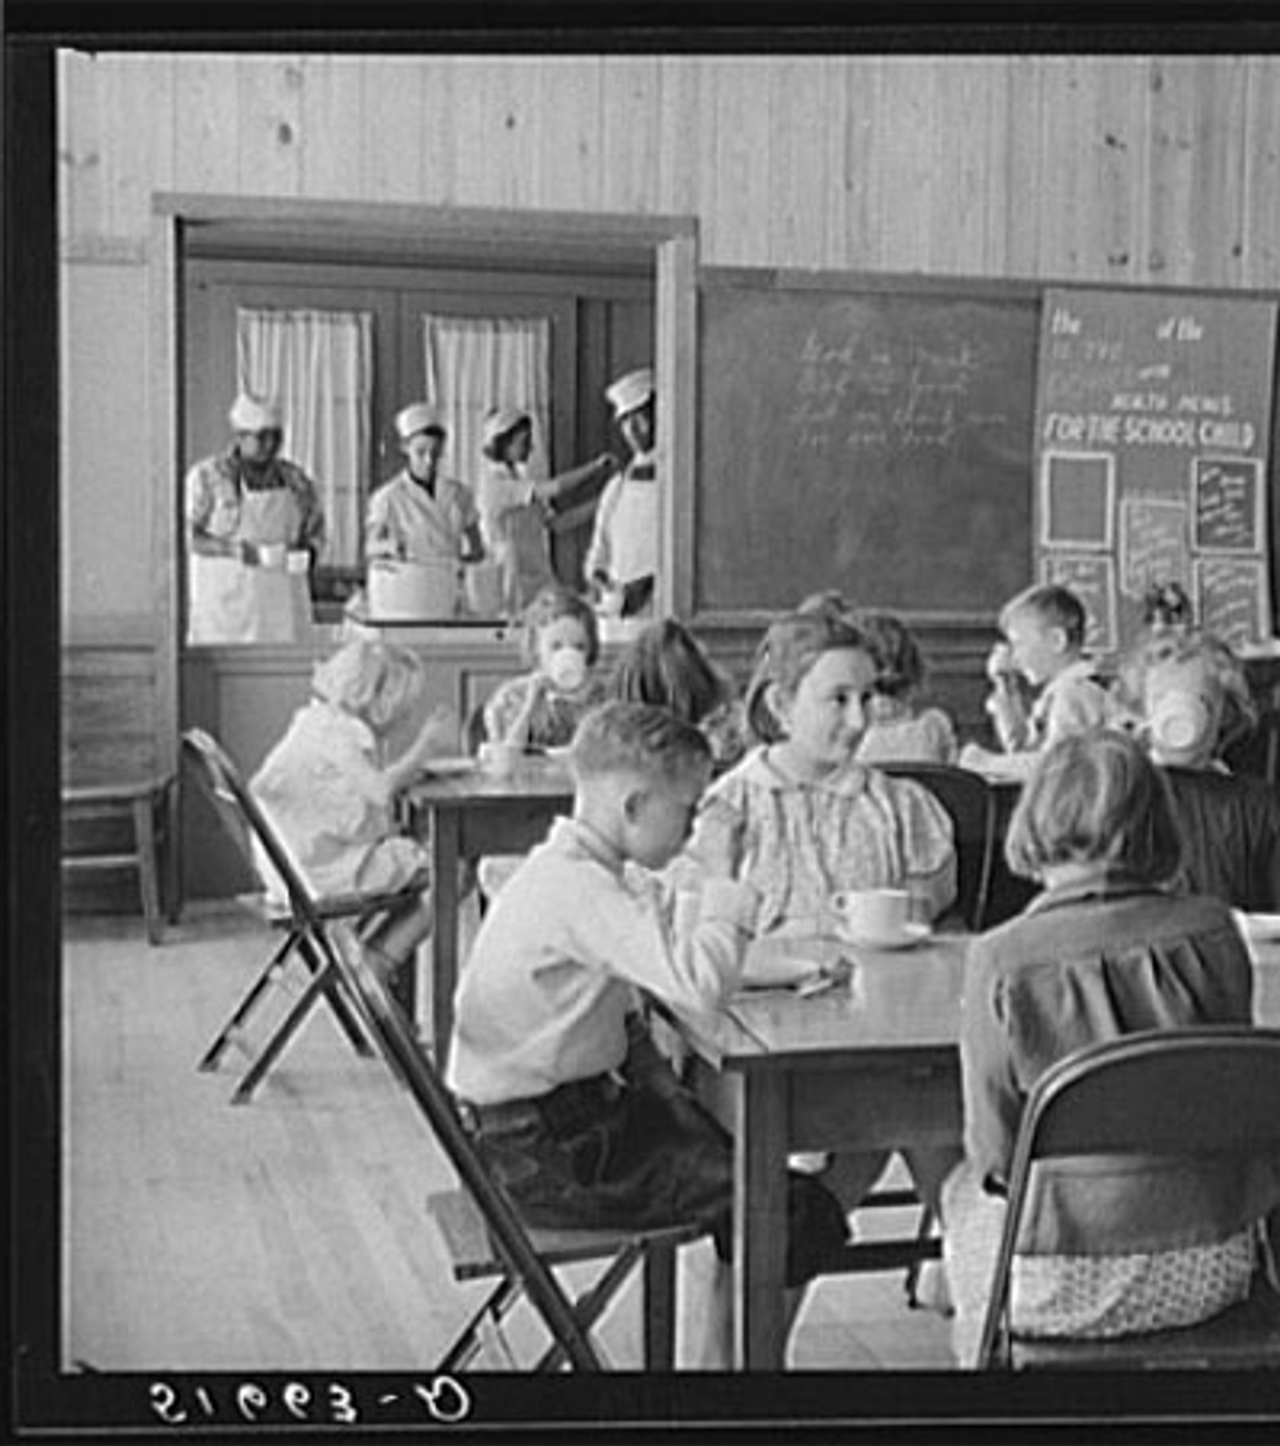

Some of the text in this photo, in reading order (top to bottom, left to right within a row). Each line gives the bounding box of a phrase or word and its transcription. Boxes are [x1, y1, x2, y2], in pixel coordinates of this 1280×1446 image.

[1044, 412, 1256, 449] FOR THE SCHOOL CHILD
